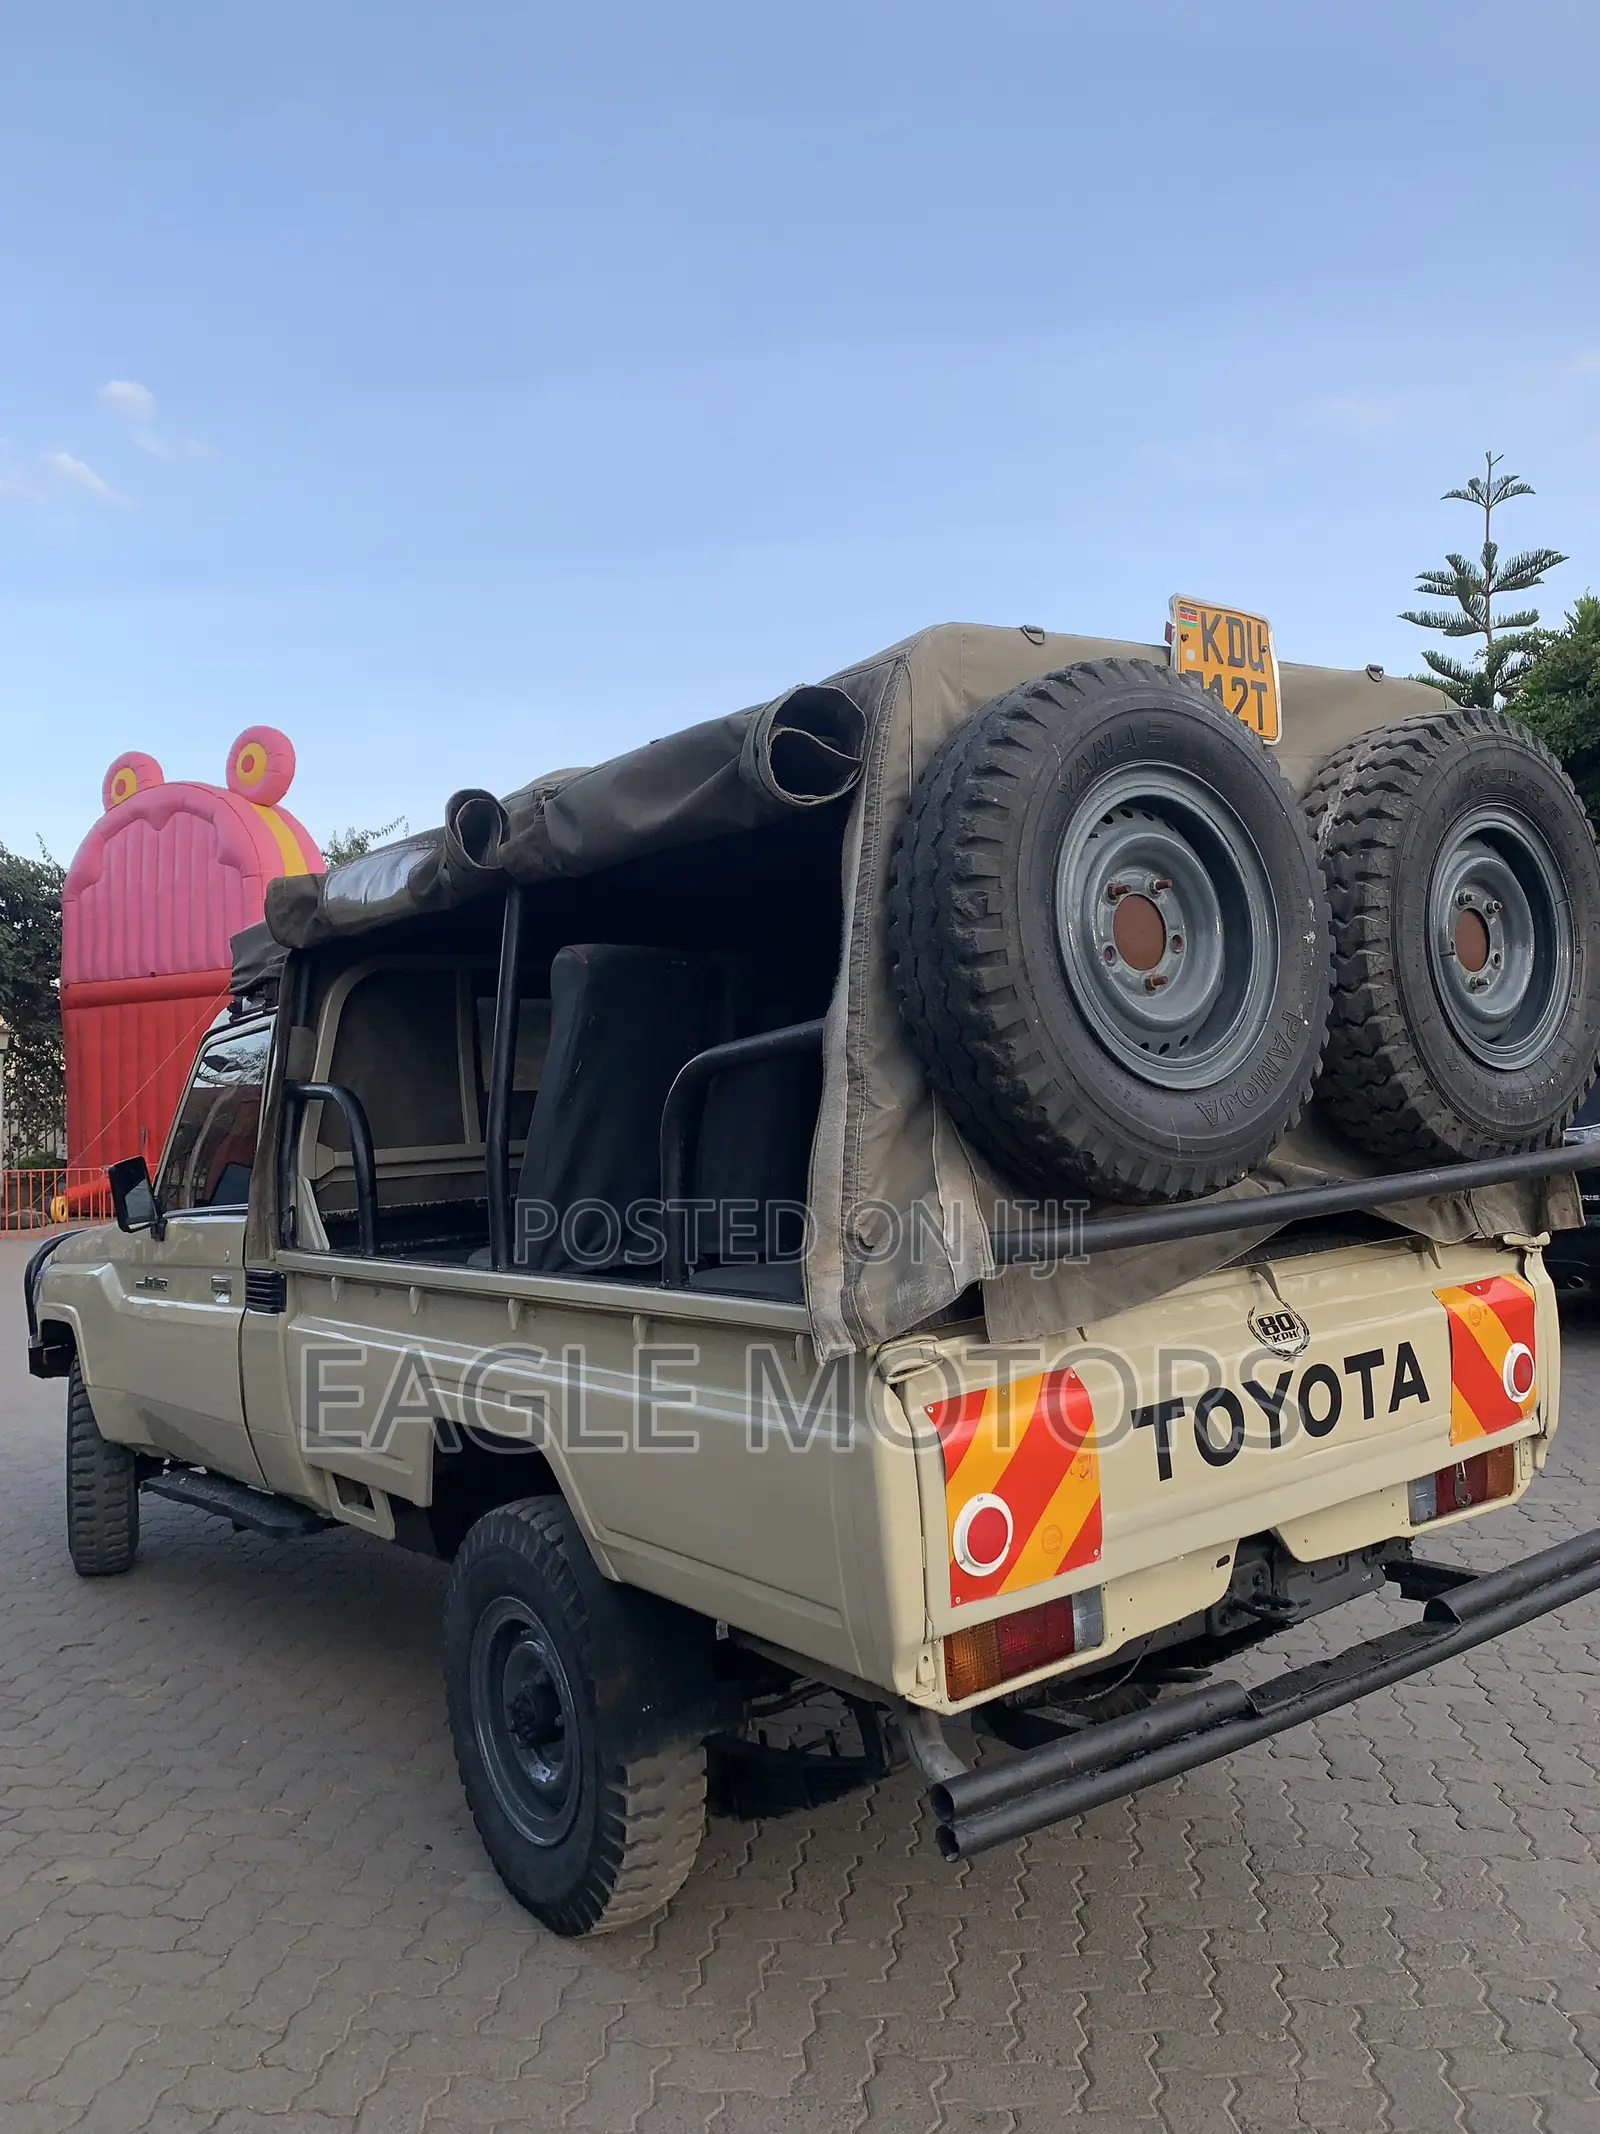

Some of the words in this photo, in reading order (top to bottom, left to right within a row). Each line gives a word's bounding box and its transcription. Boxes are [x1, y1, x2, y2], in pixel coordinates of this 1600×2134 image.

[1201, 611, 1265, 673] KDU
[1185, 669, 1268, 731] 12T
[1194, 1009, 1303, 1126] PAMOJA
[1257, 1312, 1296, 1336] 80
[1273, 1330, 1298, 1343] KPH
[1132, 1341, 1430, 1482] TOYOTA
